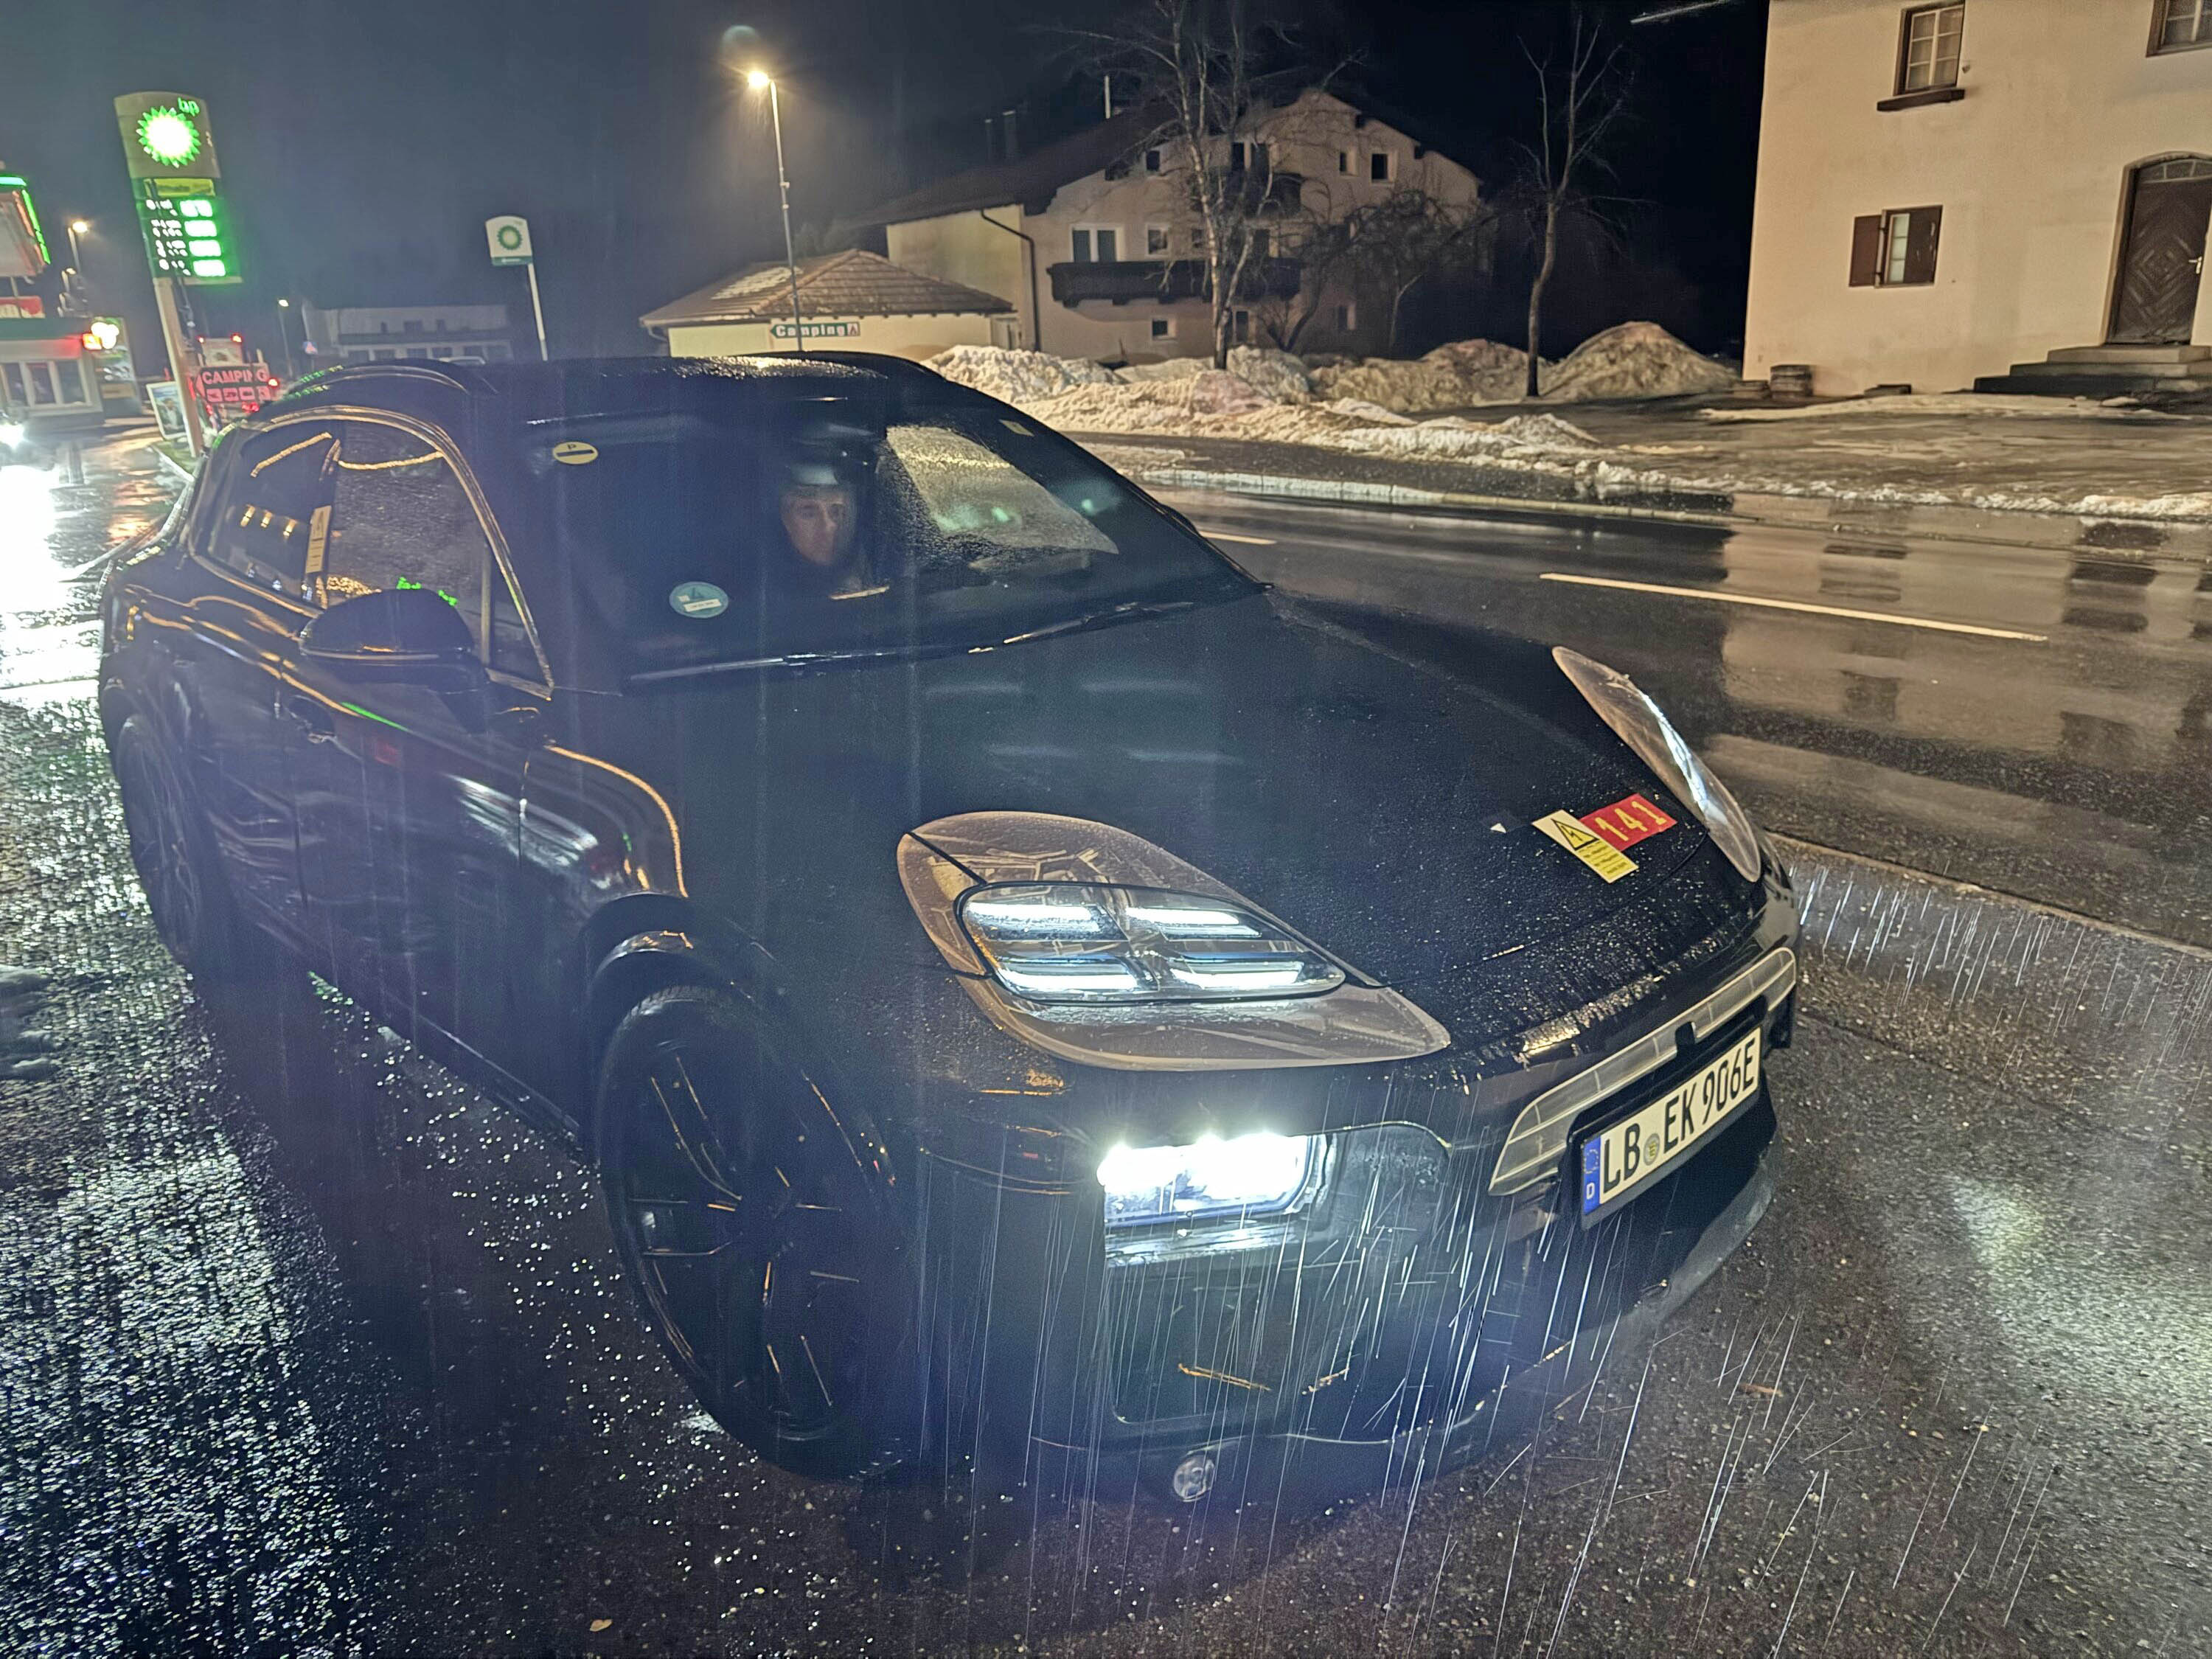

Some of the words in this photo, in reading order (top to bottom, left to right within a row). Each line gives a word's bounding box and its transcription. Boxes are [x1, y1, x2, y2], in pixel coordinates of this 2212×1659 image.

[178, 97, 200, 116] bp
[1603, 1123, 1641, 1194] LB
[1663, 1082, 1697, 1154] EK
[1702, 1037, 1756, 1125] 906E
[1586, 1182, 1596, 1200] D
